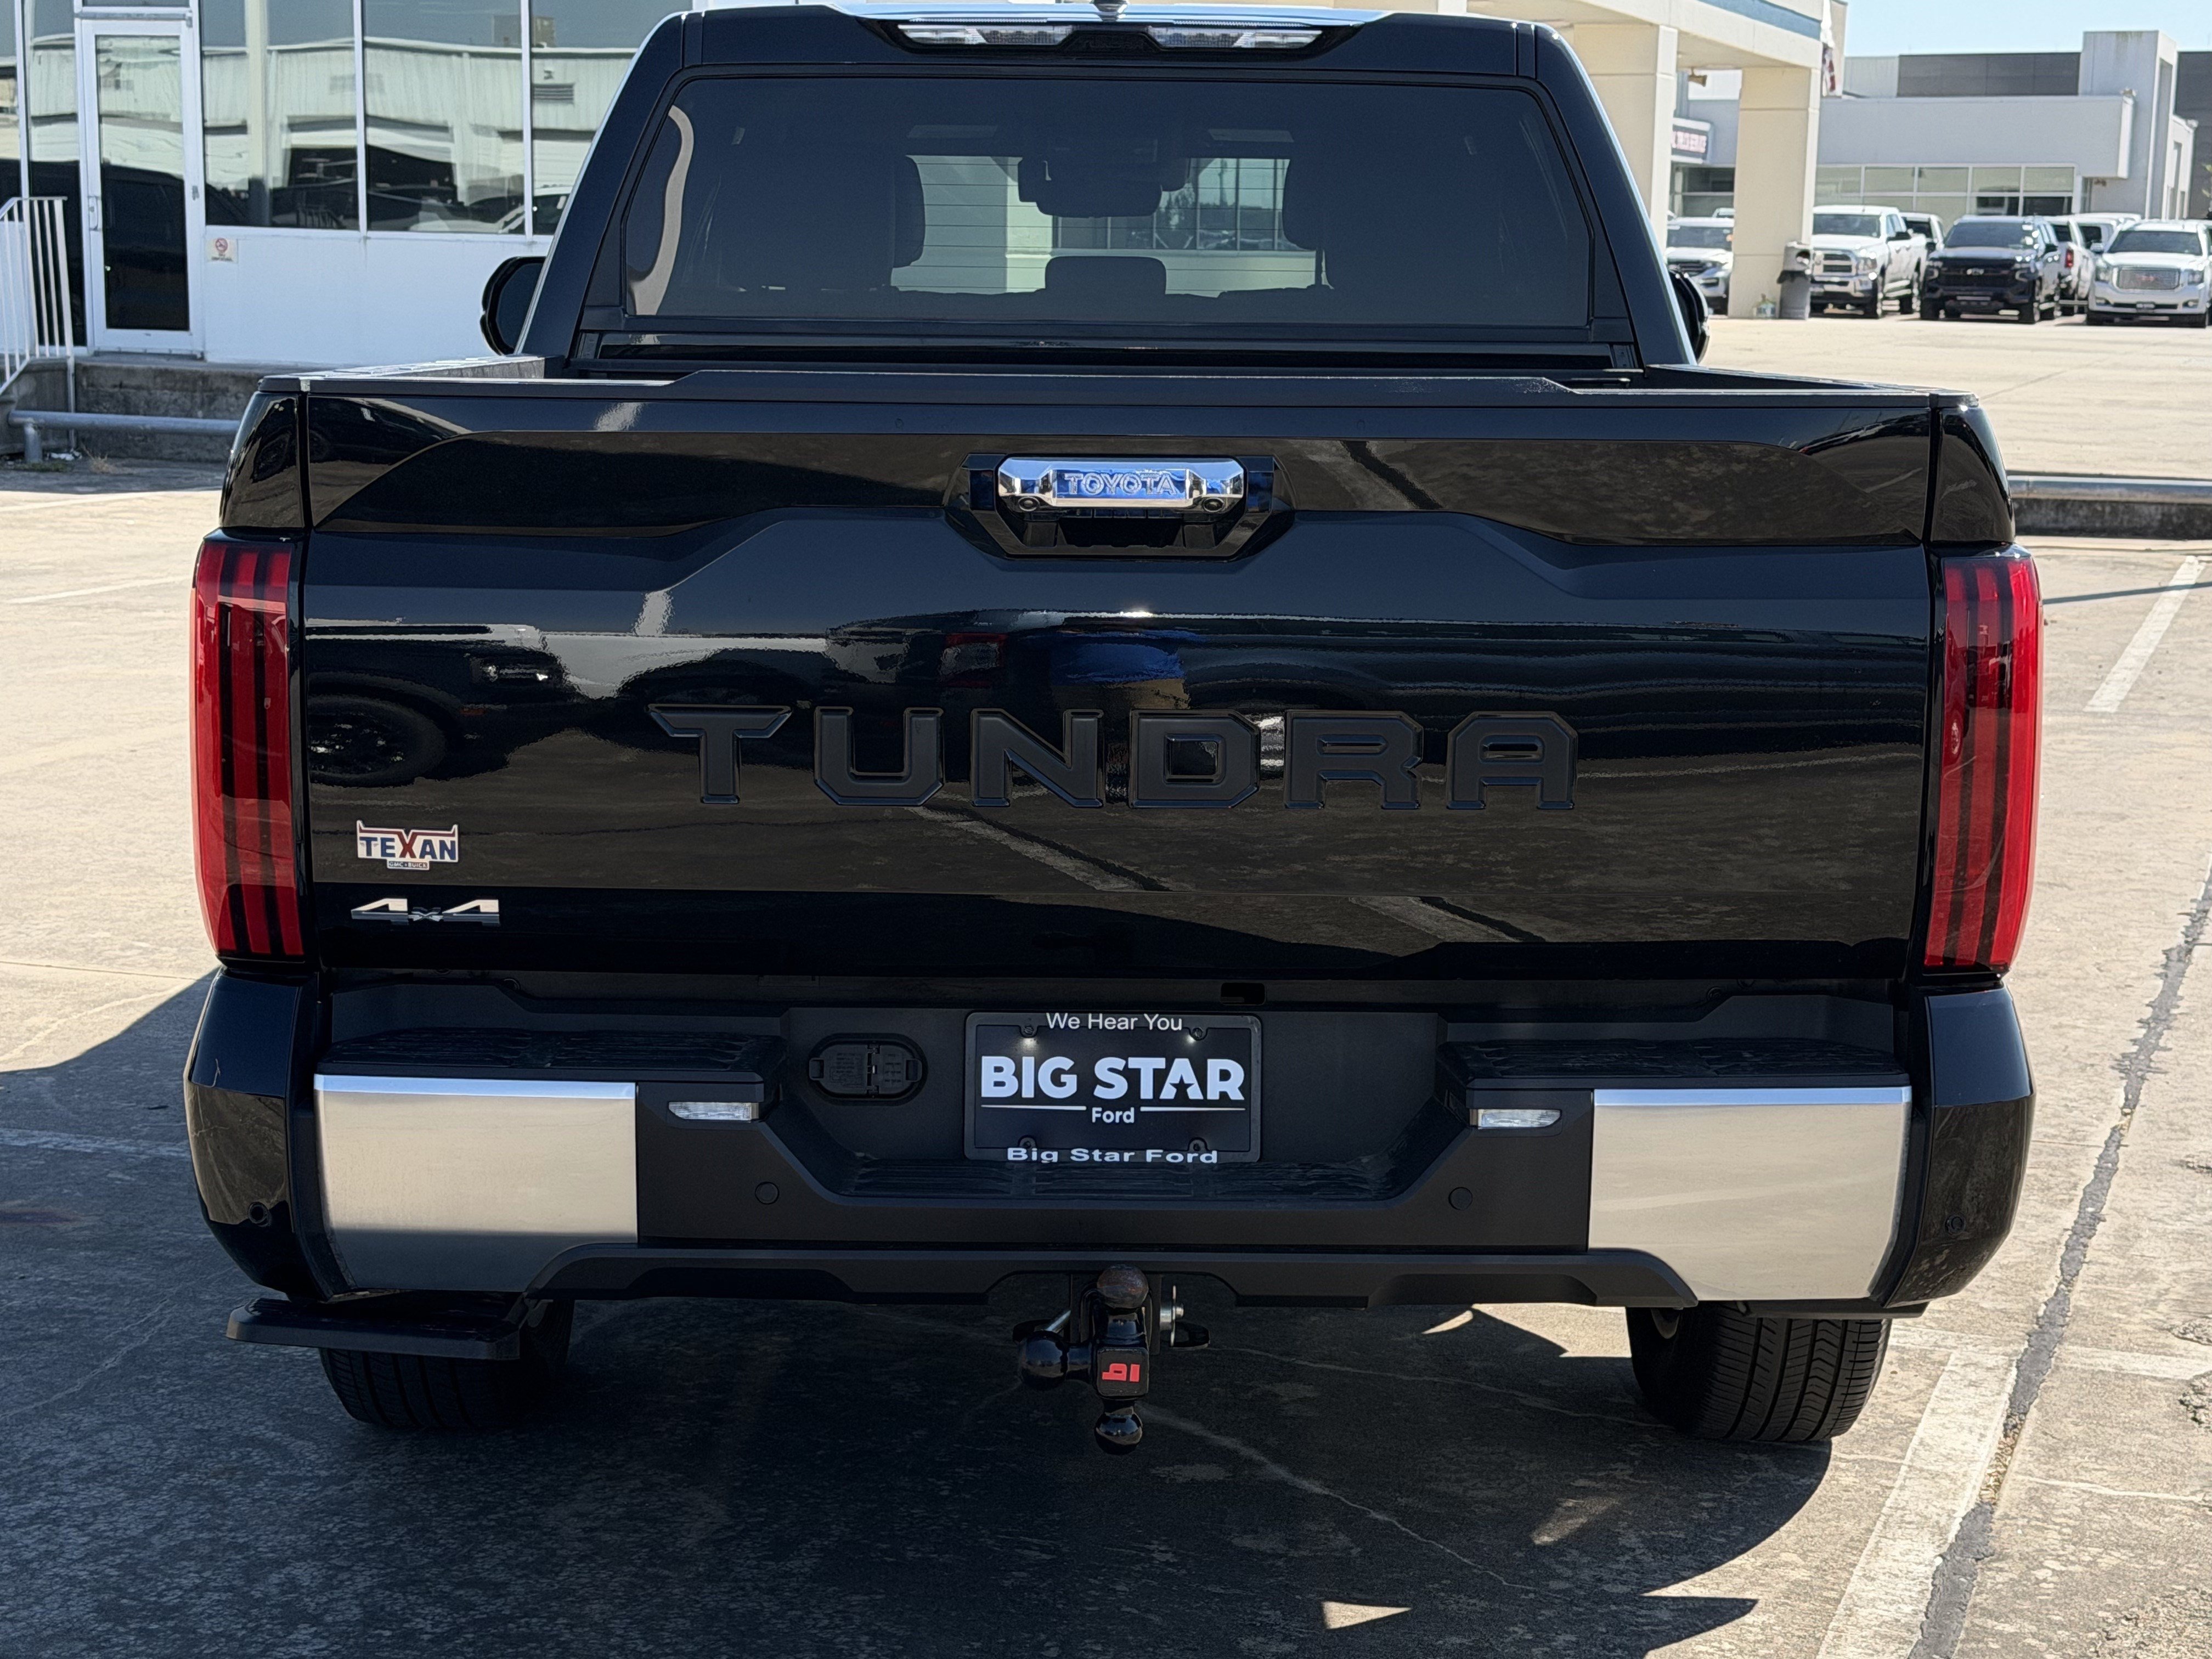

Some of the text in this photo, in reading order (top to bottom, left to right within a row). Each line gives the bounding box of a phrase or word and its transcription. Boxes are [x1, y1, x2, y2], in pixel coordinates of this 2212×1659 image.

[1064, 472, 1178, 495] TOYOTA
[647, 703, 1579, 810] TUNDRA
[358, 831, 457, 860] TEXAN
[1046, 1012, 1182, 1031] We Hear You
[981, 1056, 1245, 1101] BIG STAR
[1092, 1107, 1135, 1124] Ford
[1007, 1147, 1217, 1164] Big Star Ford
